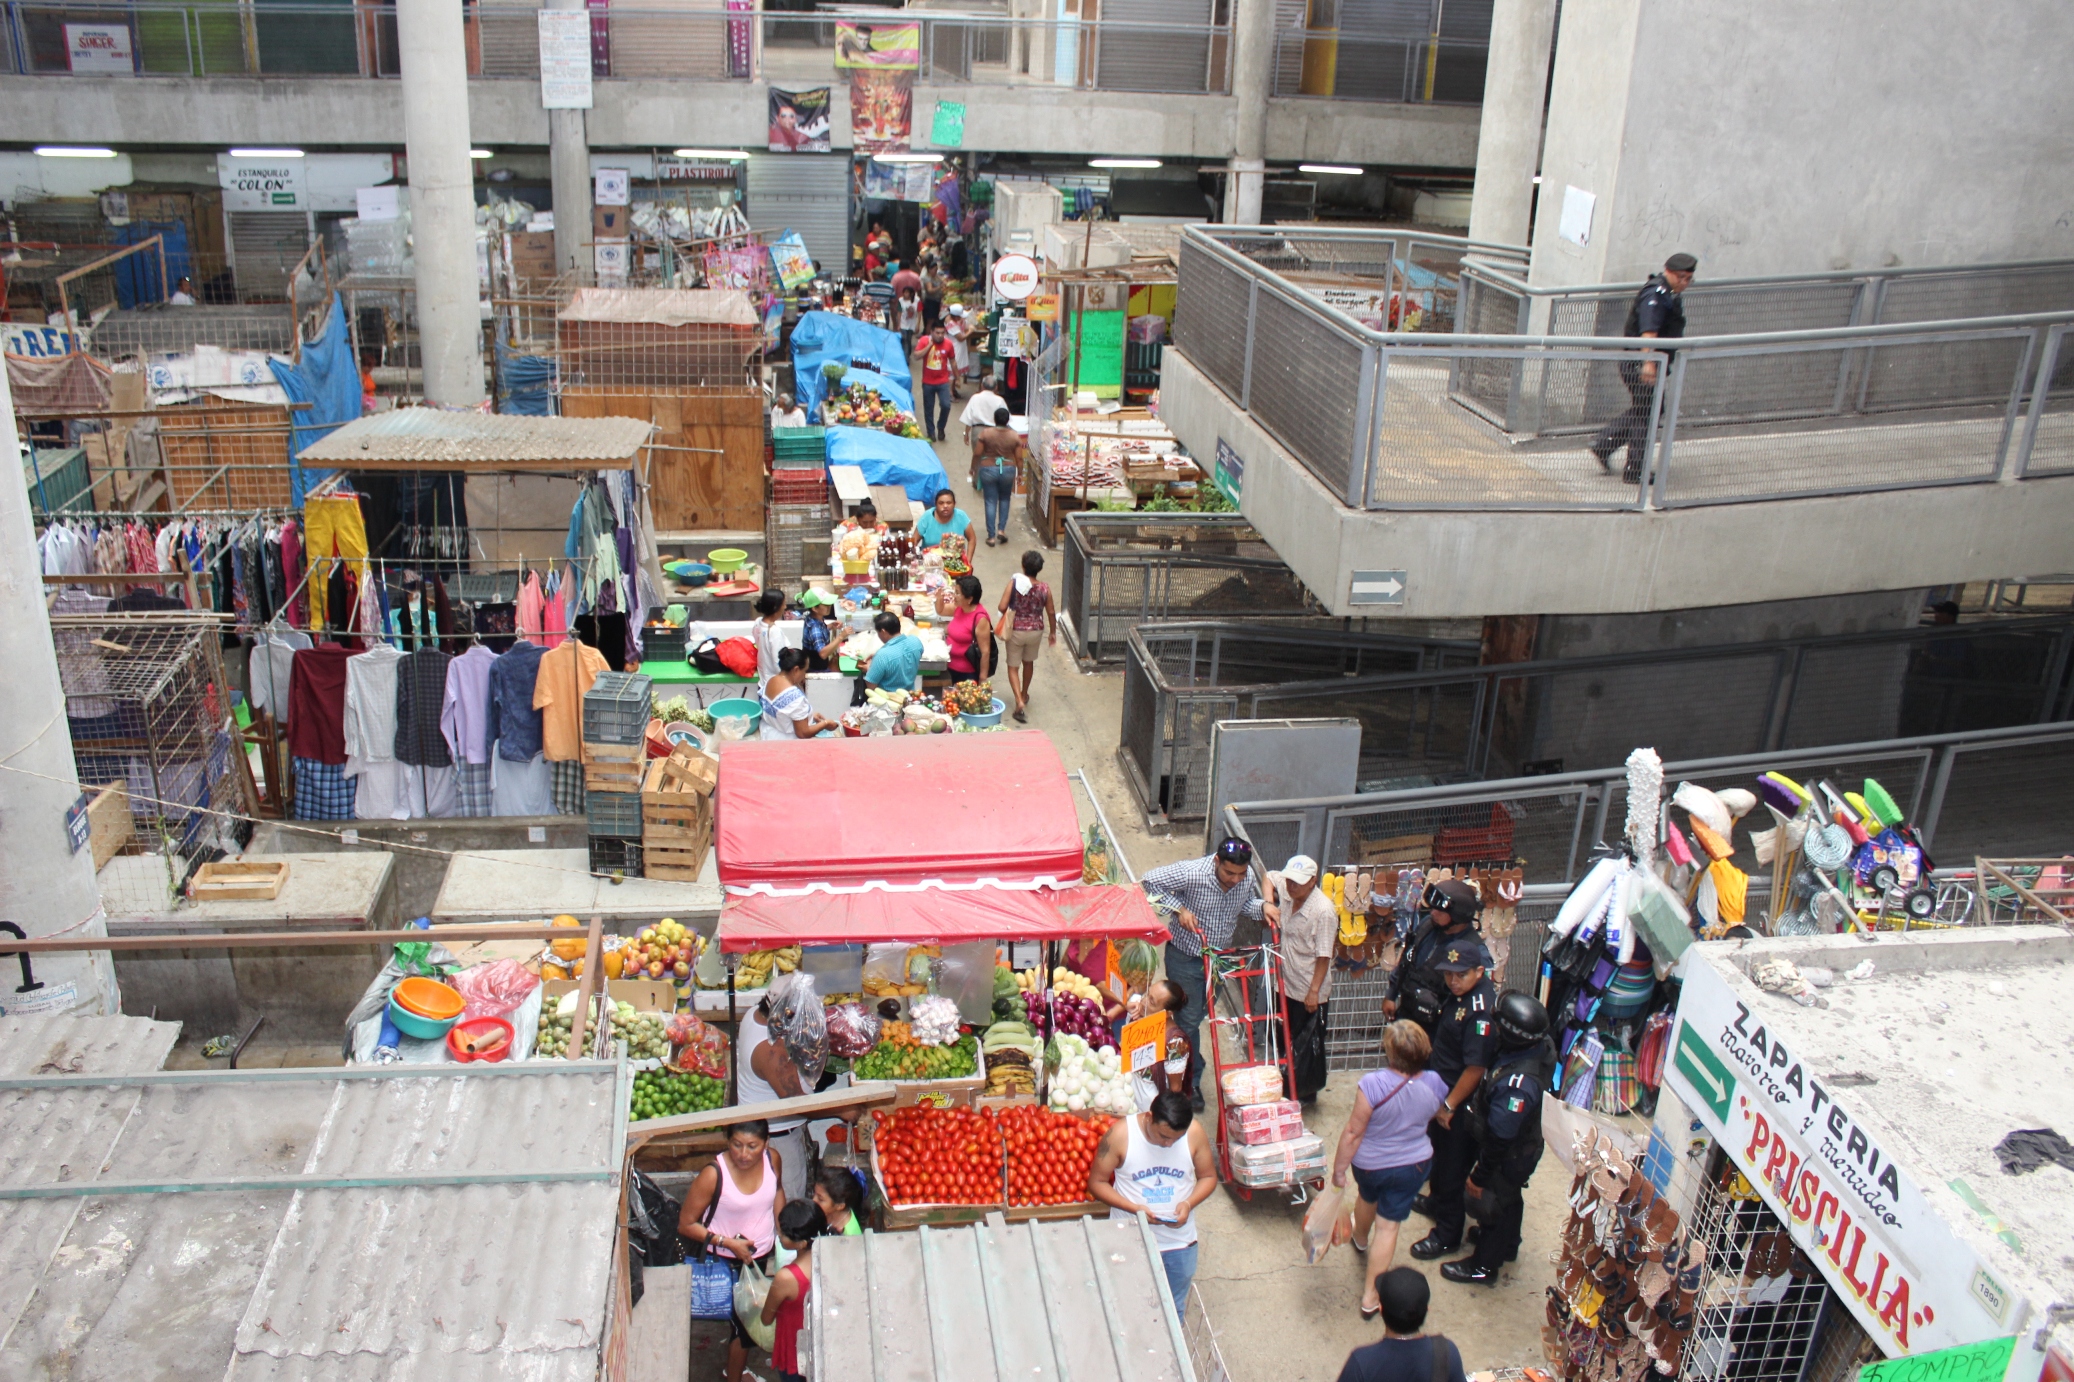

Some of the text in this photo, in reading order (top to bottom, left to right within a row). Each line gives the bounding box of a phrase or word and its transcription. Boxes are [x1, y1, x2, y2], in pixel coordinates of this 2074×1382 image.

[238, 169, 289, 178] ESTANQUILLO
[1472, 994, 1485, 1011] H
[1123, 1020, 1166, 1045] TOMATE
[1508, 1073, 1525, 1088] H
[1733, 1000, 1900, 1203] ZAPATERIA
[1799, 1116, 1815, 1136] y
[1131, 1165, 1185, 1182] ACAPULCO
[1982, 1271, 2003, 1295] FOLIO
[1980, 1283, 1999, 1308] 1890
